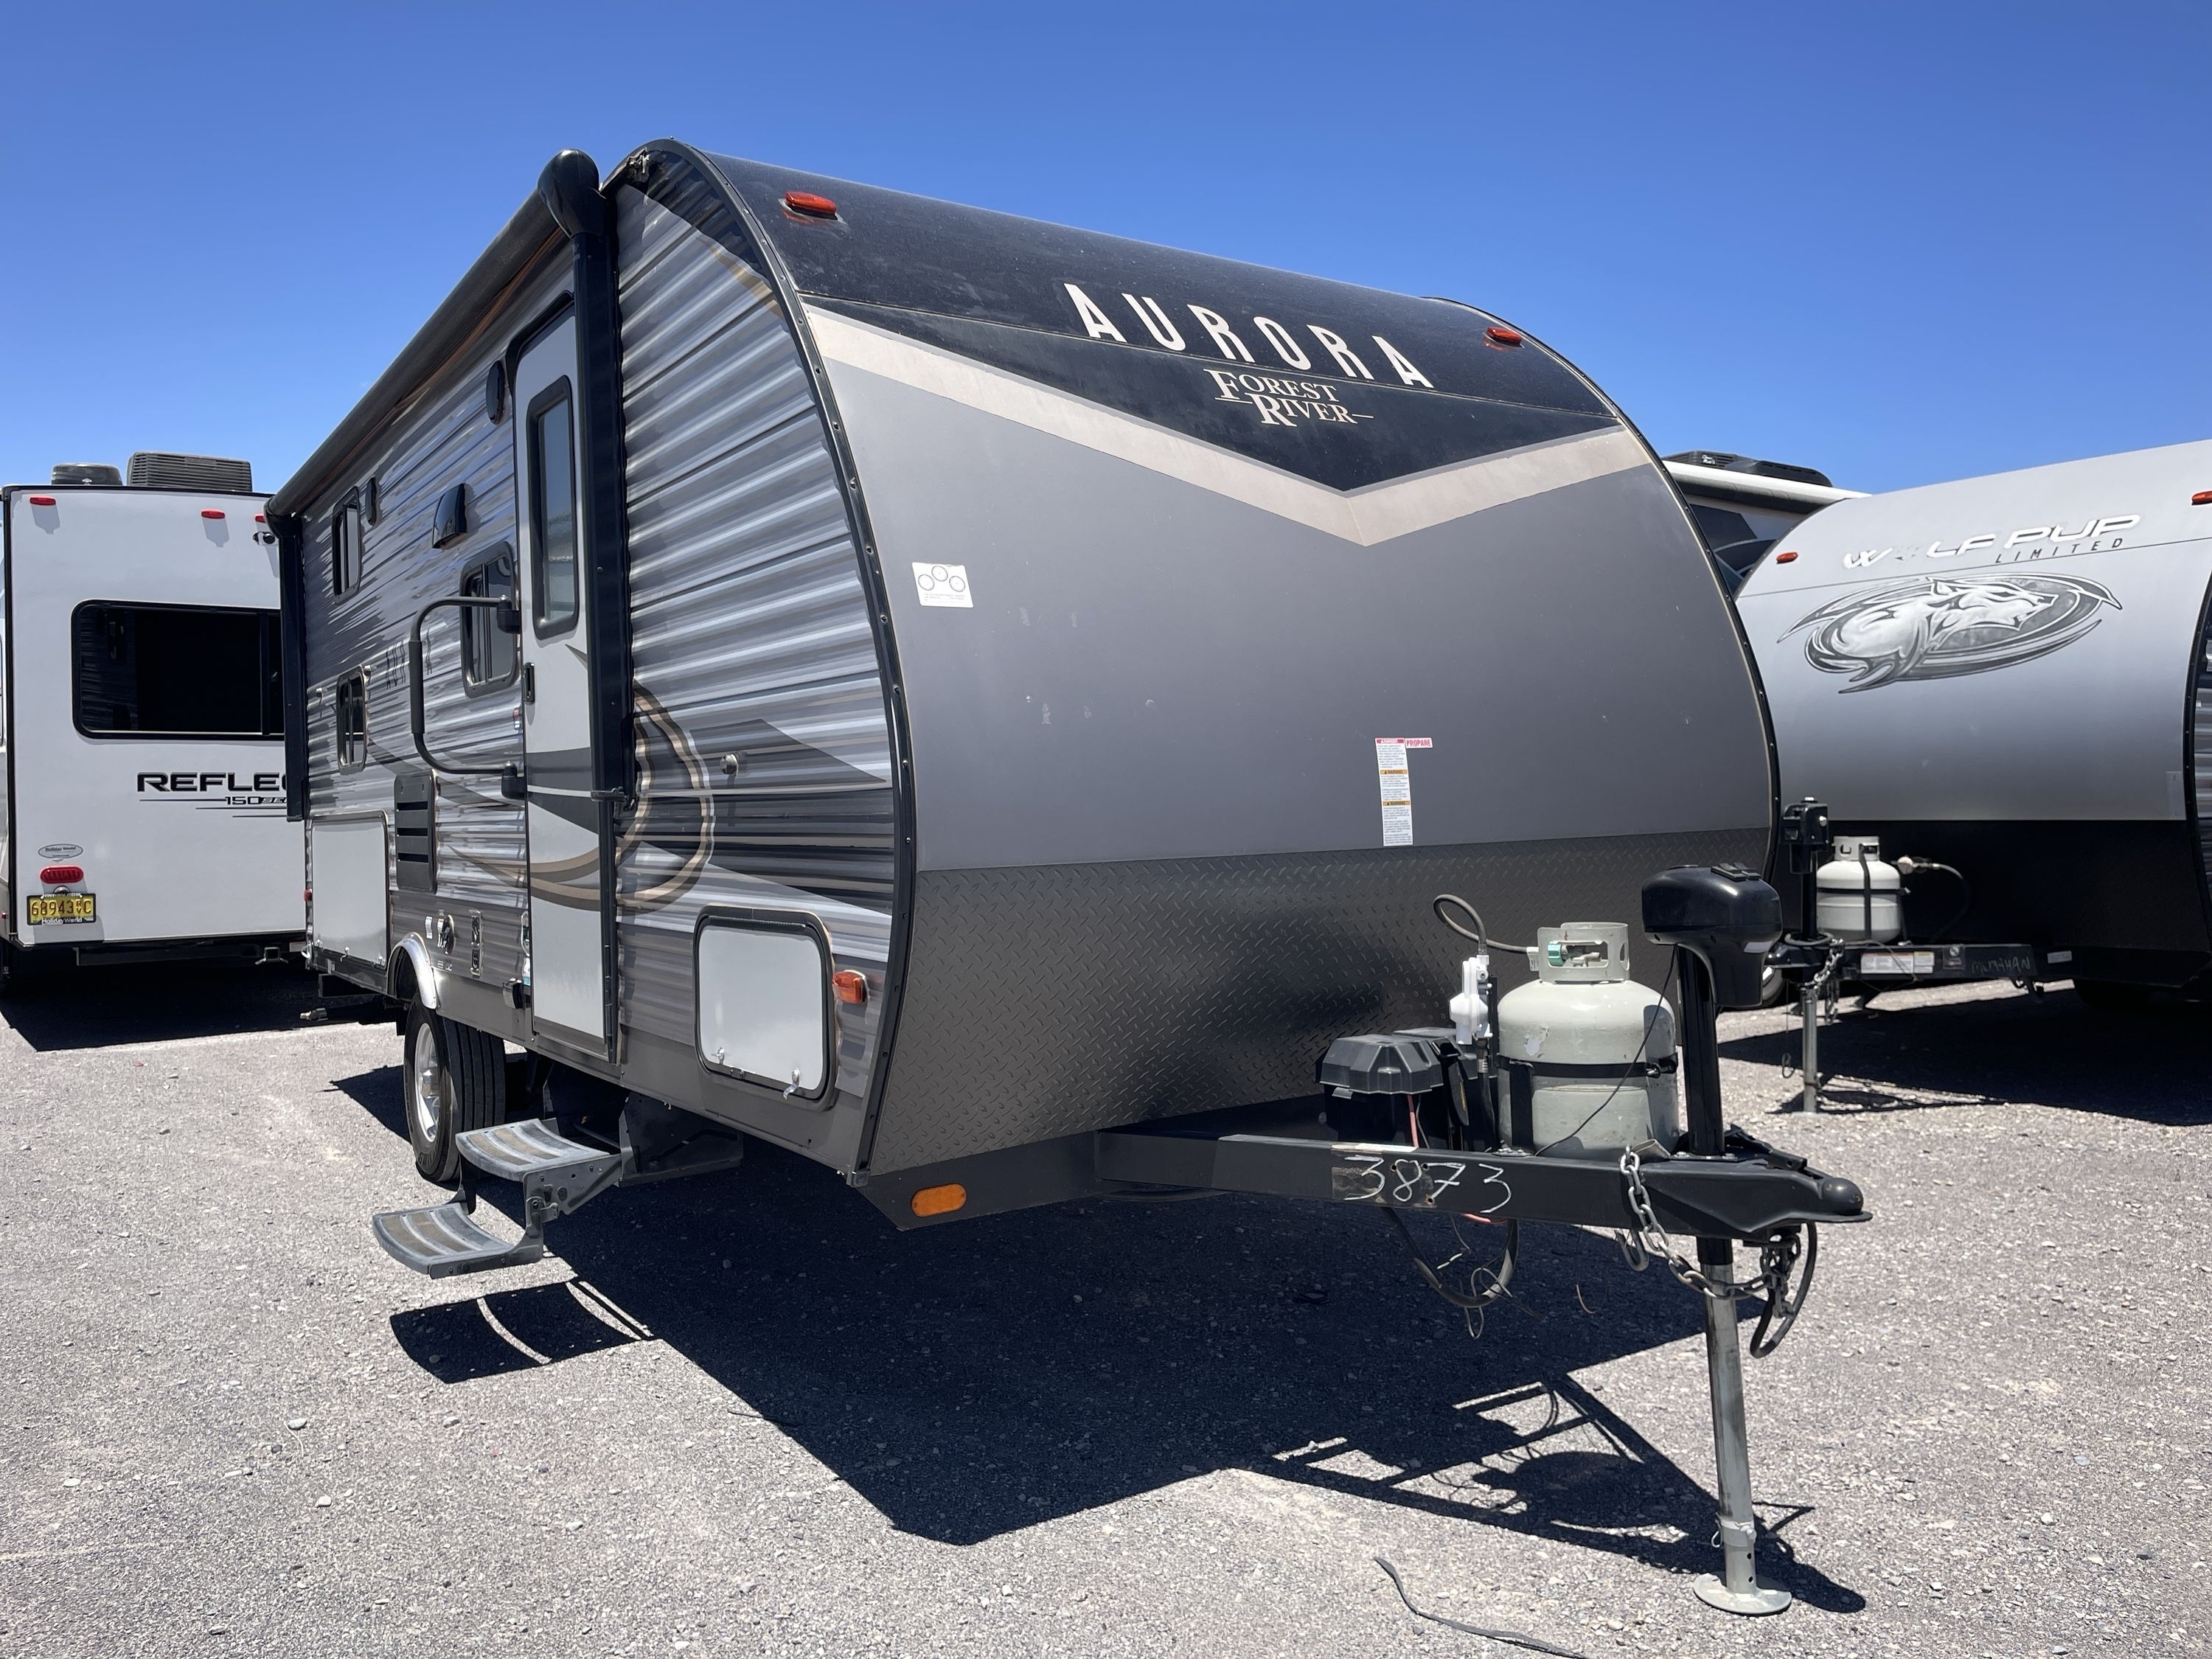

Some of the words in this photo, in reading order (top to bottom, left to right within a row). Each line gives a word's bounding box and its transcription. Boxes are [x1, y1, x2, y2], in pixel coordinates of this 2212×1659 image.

[1063, 283, 1435, 389] AURORA
[1203, 368, 1340, 403] FOREST
[1244, 392, 1359, 428] RIVER
[1843, 533, 1995, 569] WLF
[2003, 514, 2140, 549] PUP
[1994, 538, 2123, 564] LIMITED
[137, 772, 287, 793] REFLE
[225, 796, 261, 805] 150
[1343, 1153, 1512, 1214] 3873
